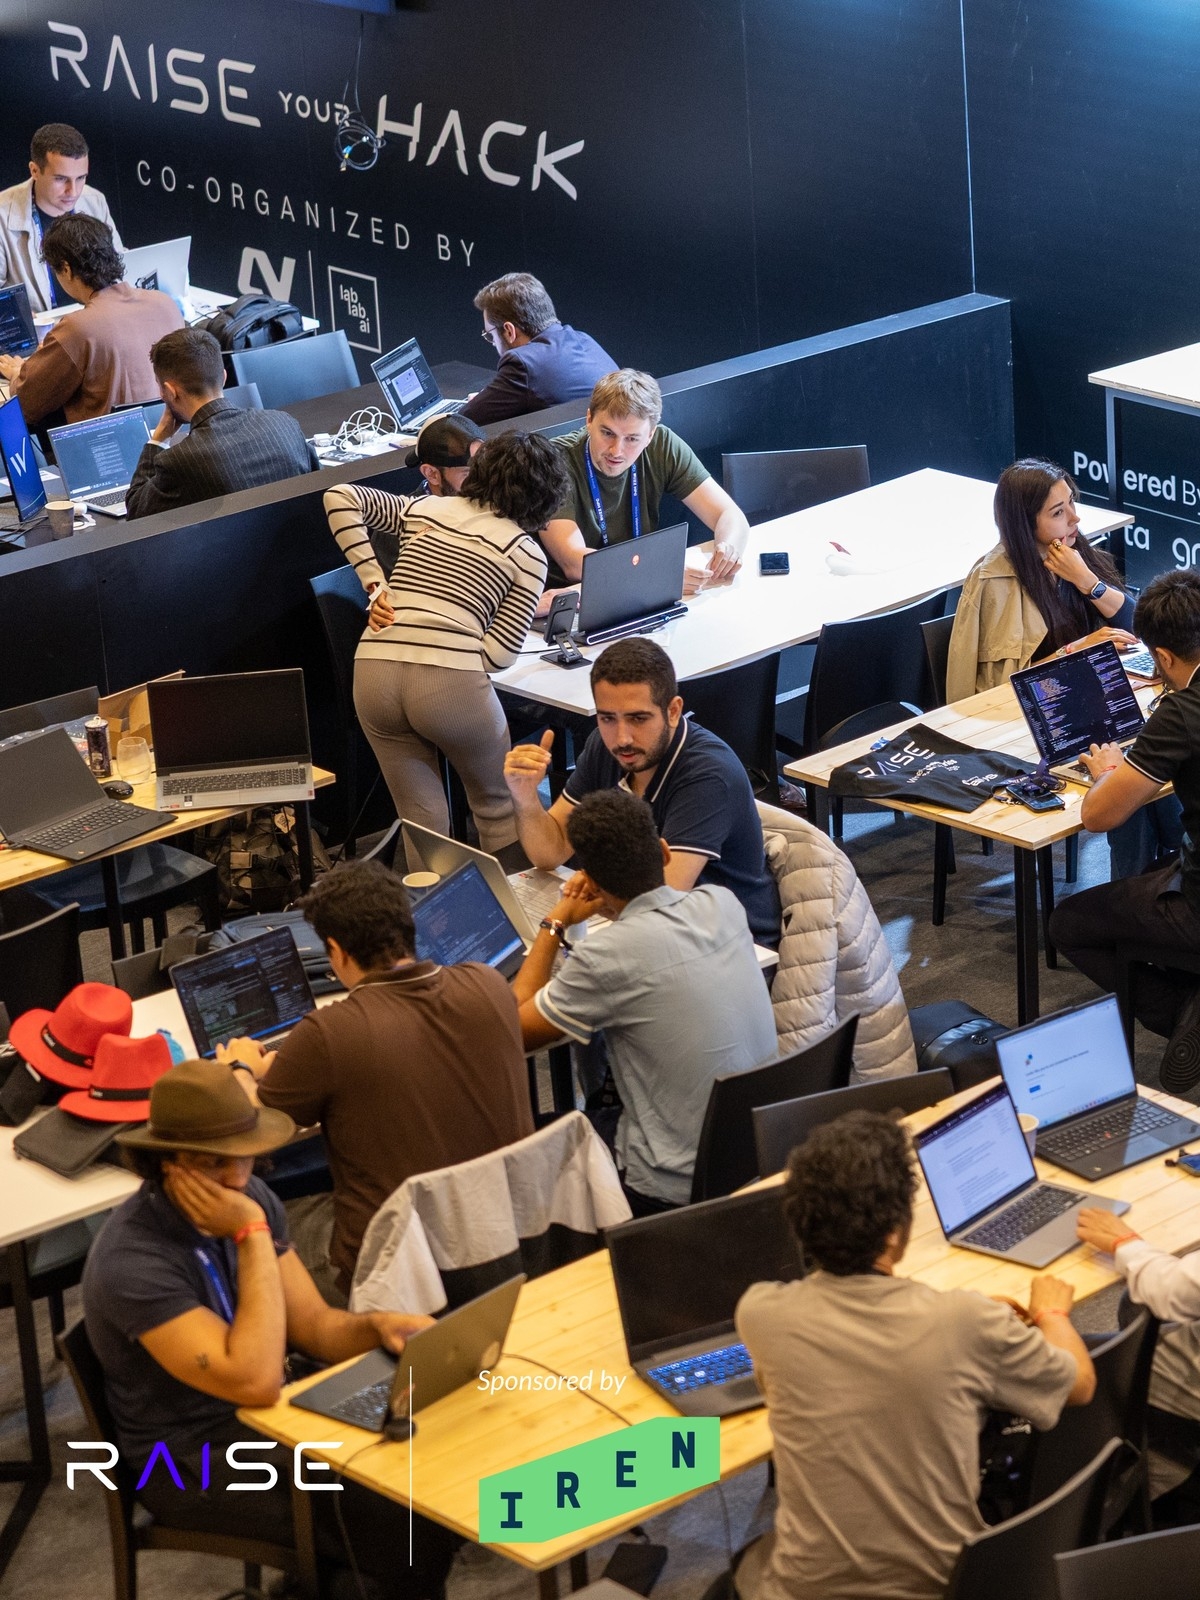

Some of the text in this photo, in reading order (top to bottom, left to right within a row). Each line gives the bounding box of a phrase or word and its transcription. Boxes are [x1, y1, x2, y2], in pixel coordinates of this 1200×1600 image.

[48, 21, 585, 201] RAISE YOUR HACK
[137, 160, 474, 267] CO-ORGANIZED BY
[340, 284, 358, 304] lab
[348, 301, 366, 319] lab
[359, 317, 380, 334] ai
